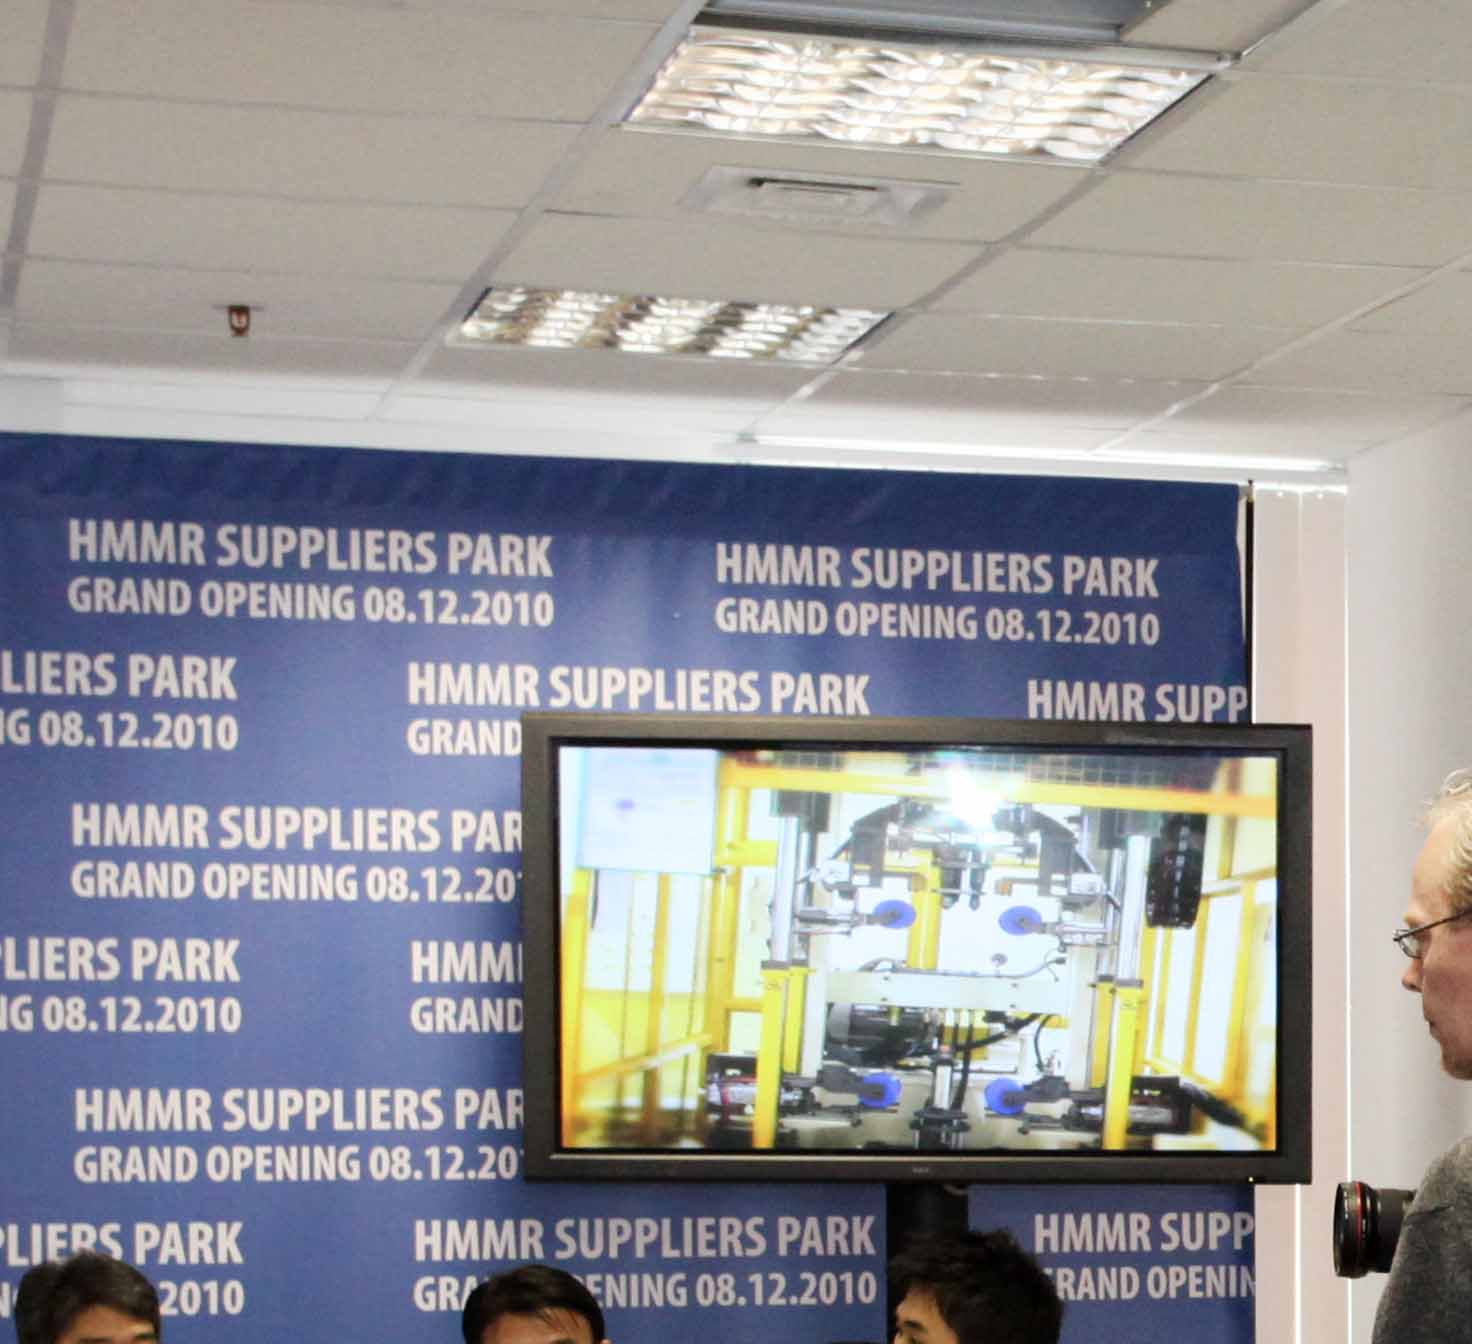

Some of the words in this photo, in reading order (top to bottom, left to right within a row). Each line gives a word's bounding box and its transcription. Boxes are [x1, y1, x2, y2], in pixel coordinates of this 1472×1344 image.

[69, 518, 206, 566] HMMR
[216, 524, 438, 575] SUPPLIERS
[448, 533, 554, 578] PARK
[716, 542, 841, 588] HMMR
[850, 547, 1054, 594] SUPPLIERS
[1063, 555, 1159, 598] PARK
[67, 576, 192, 616] GRAND
[199, 581, 356, 622] OPENING
[363, 587, 555, 627] 08.12.2010
[714, 597, 828, 635] GRAND
[834, 601, 978, 640] OPENING
[984, 607, 1160, 646] 08.12.2010
[128, 654, 238, 701] PARK
[408, 662, 540, 707] HMMR
[549, 665, 761, 713] SUPPLIERS
[771, 673, 870, 716] PARK
[1027, 679, 1146, 722] HMMR
[1155, 684, 1247, 723] SUPP
[39, 711, 239, 752] 08.12.2010
[407, 718, 522, 755] GRAND
[72, 803, 210, 849] HMMR
[219, 805, 441, 852] SUPPLIERS
[452, 810, 522, 852] PAR
[71, 861, 195, 899] GRAND
[202, 863, 358, 901] OPENING
[366, 866, 522, 903] 08.12.20
[0, 937, 120, 981] LIERS
[132, 938, 241, 982] PARK
[411, 941, 523, 983] HMM
[42, 996, 242, 1033] 08.12.2010
[411, 997, 523, 1033] GRAND
[75, 1087, 213, 1132] HMMR
[222, 1087, 444, 1132] SUPPLIERS
[455, 1089, 524, 1130] PAR
[74, 1145, 198, 1183] GRAND
[206, 1145, 361, 1182] OPENING
[369, 1145, 524, 1181] 08.12.20
[0, 1222, 123, 1266] LIERS
[134, 1221, 243, 1265] PARK
[414, 1219, 544, 1262] HMMR
[554, 1216, 767, 1260] SUPPLIERS
[777, 1215, 876, 1257] PARK
[1034, 1212, 1152, 1254] HMMR
[1160, 1212, 1255, 1252] SUPP
[585, 1272, 688, 1308] ENING
[695, 1271, 877, 1307] 08.12.2010
[1045, 1267, 1140, 1300] RAND
